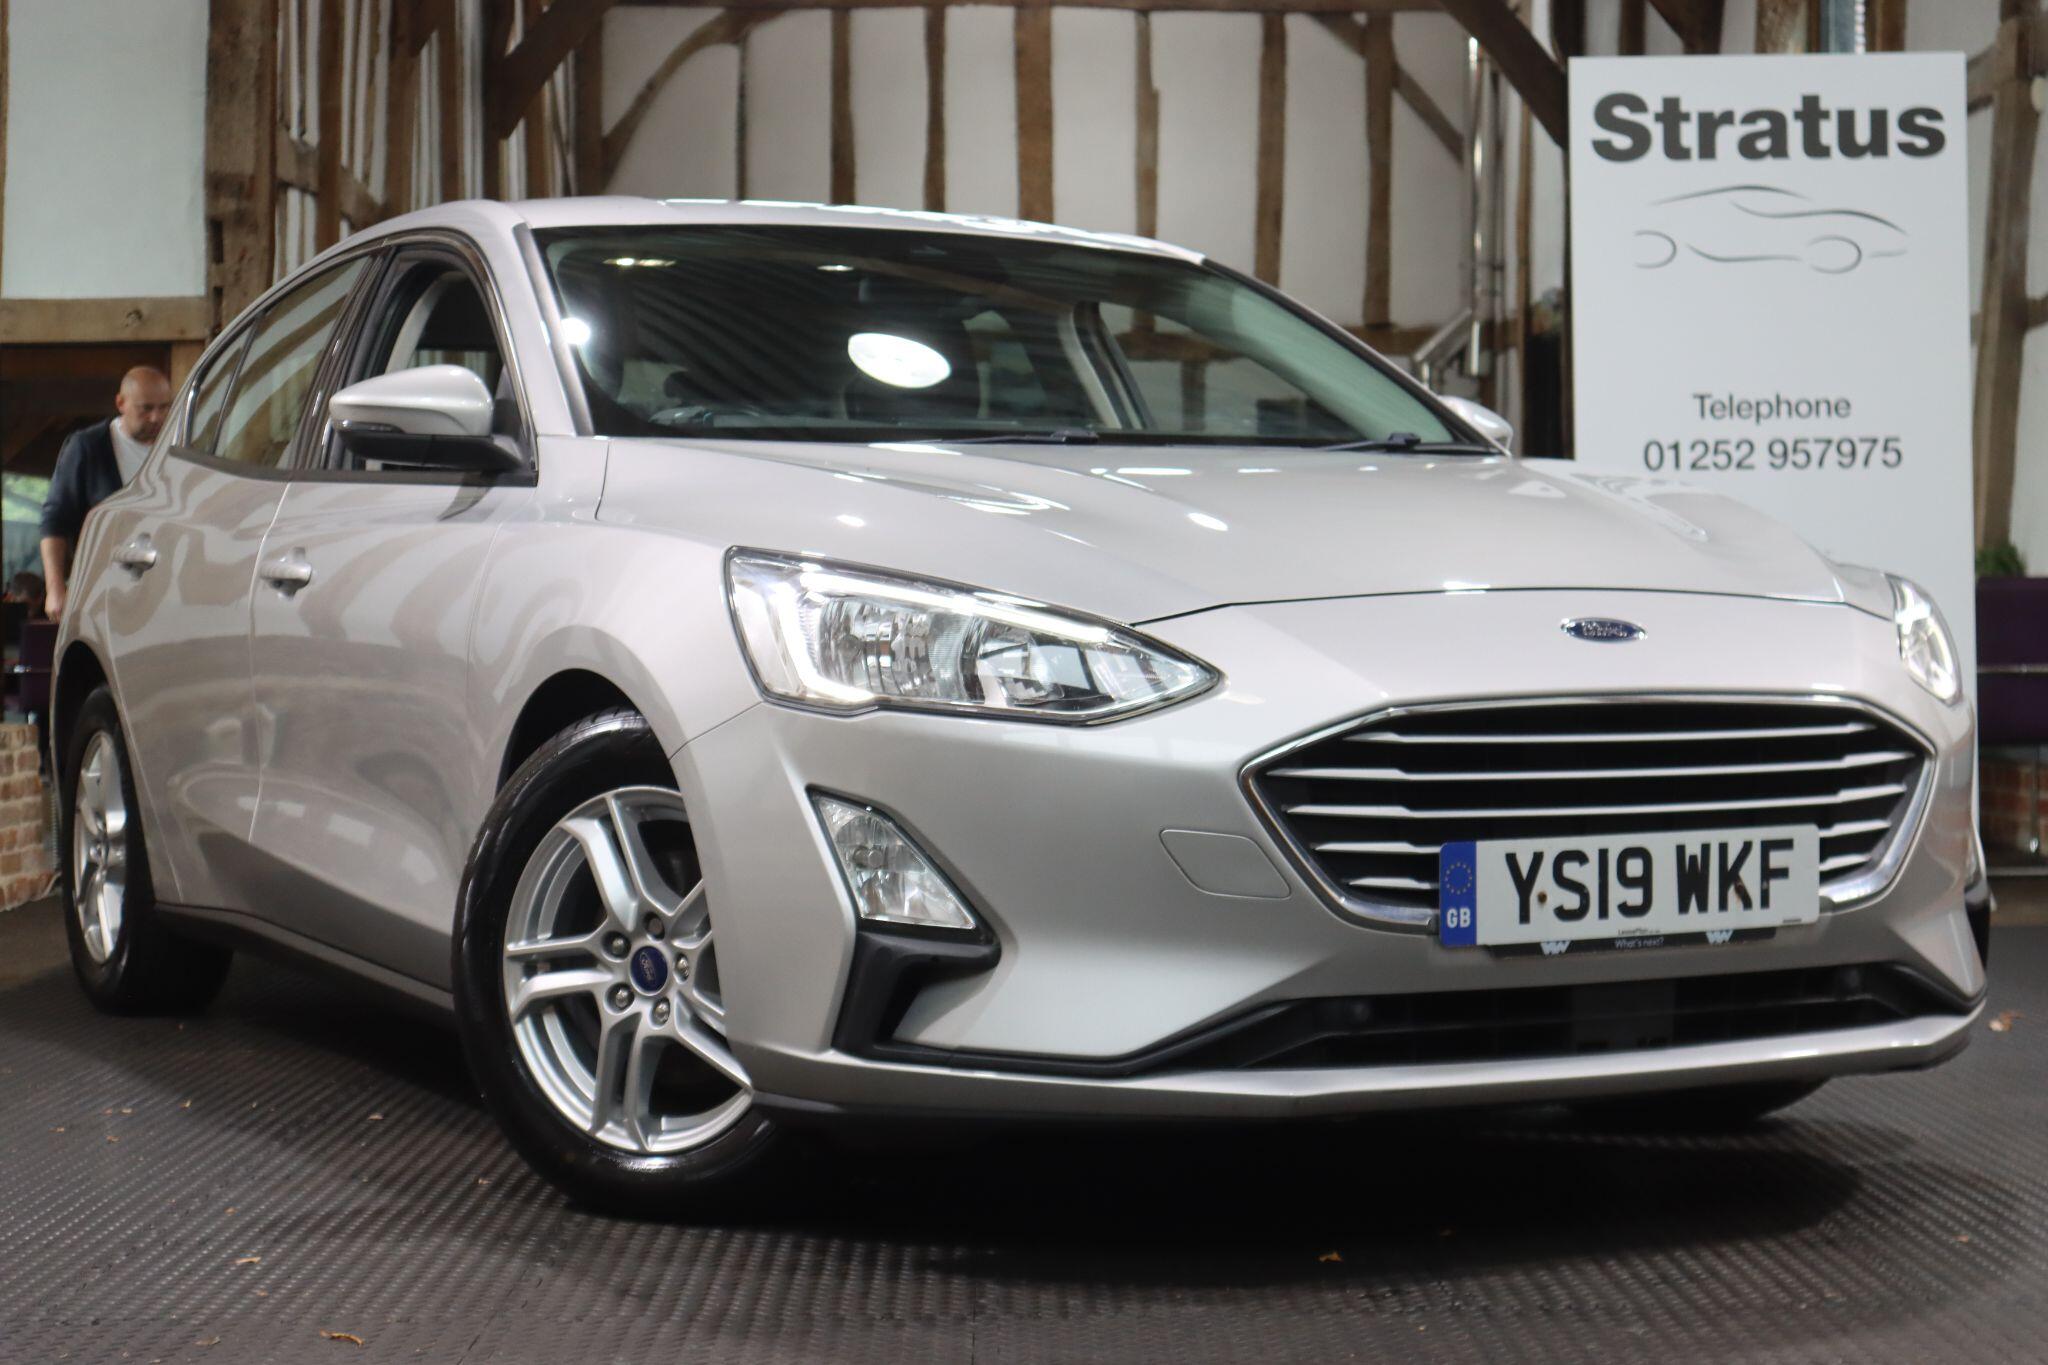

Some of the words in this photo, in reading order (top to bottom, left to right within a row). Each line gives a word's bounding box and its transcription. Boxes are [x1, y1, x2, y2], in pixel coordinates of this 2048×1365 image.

[1591, 92, 1946, 162] Stratus
[1693, 392, 1851, 425] Telephone
[1643, 440, 1756, 471] 01252
[1768, 437, 1904, 470] 957975
[1675, 838, 1794, 915] WKF
[1446, 907, 1471, 928] GB
